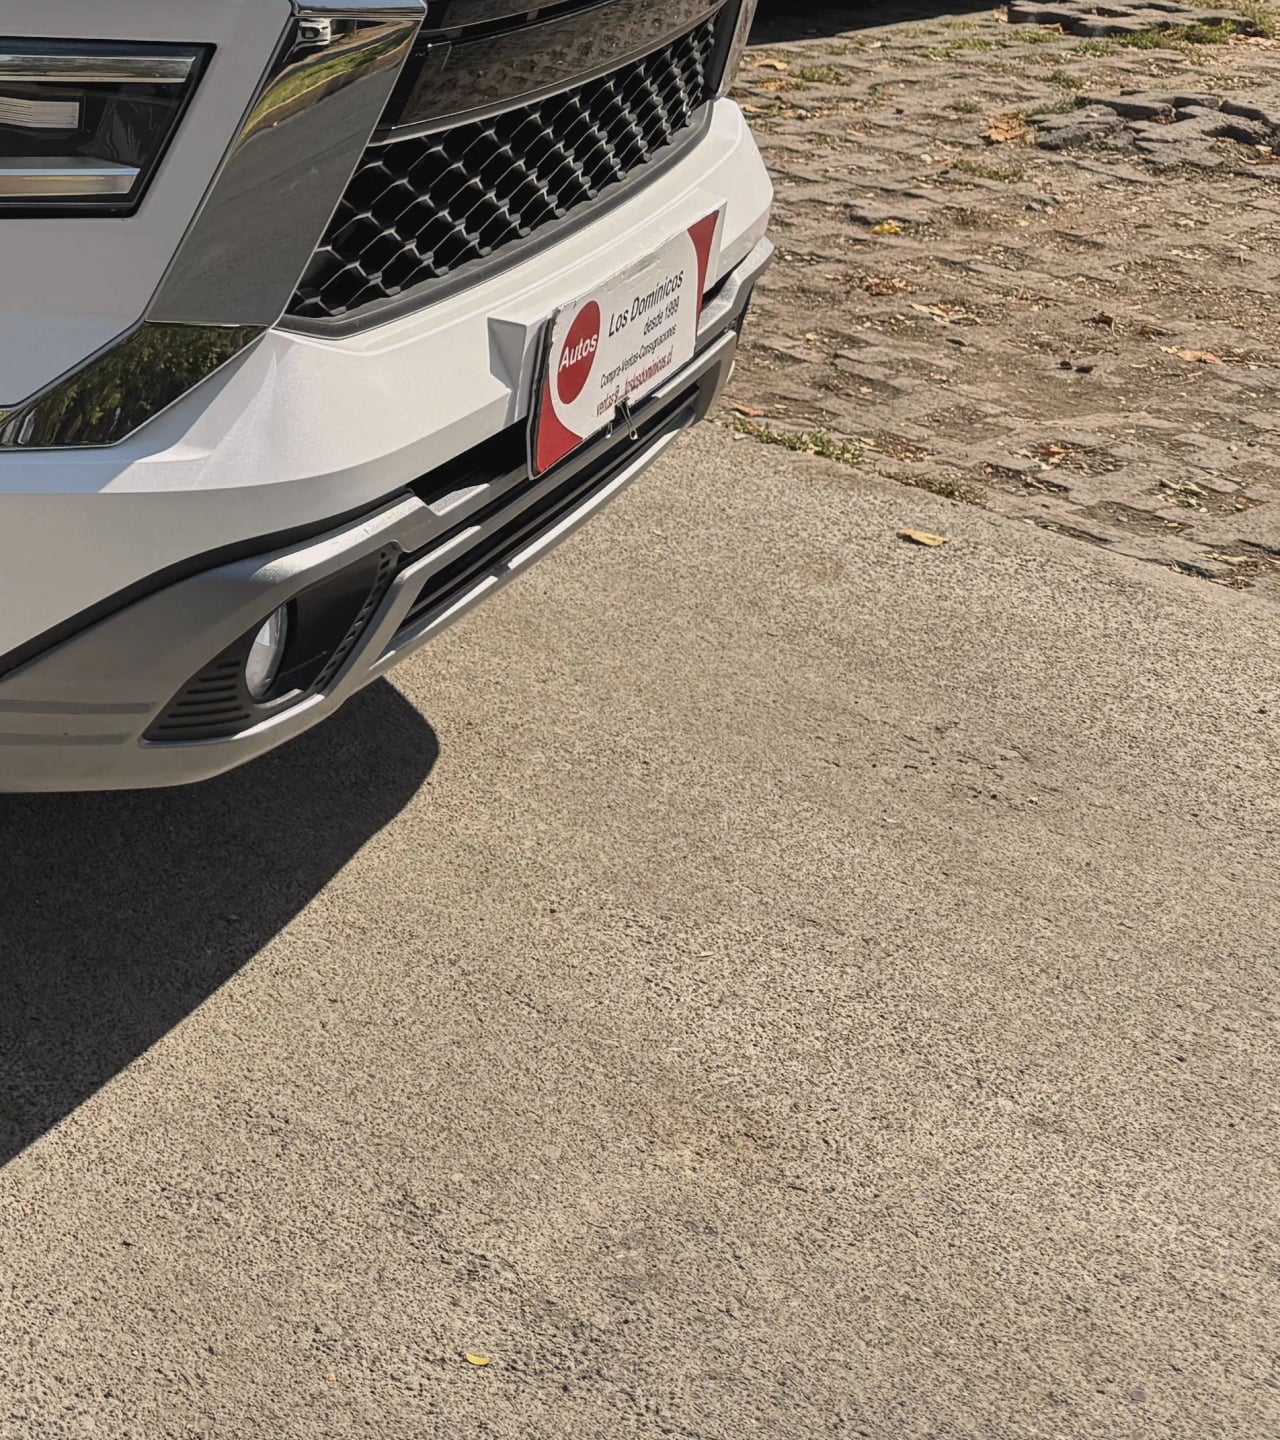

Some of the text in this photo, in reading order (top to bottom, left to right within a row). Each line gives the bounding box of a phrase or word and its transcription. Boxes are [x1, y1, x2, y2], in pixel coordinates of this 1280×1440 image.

[608, 269, 684, 338] Los Dominicos
[558, 332, 598, 373] Autos
